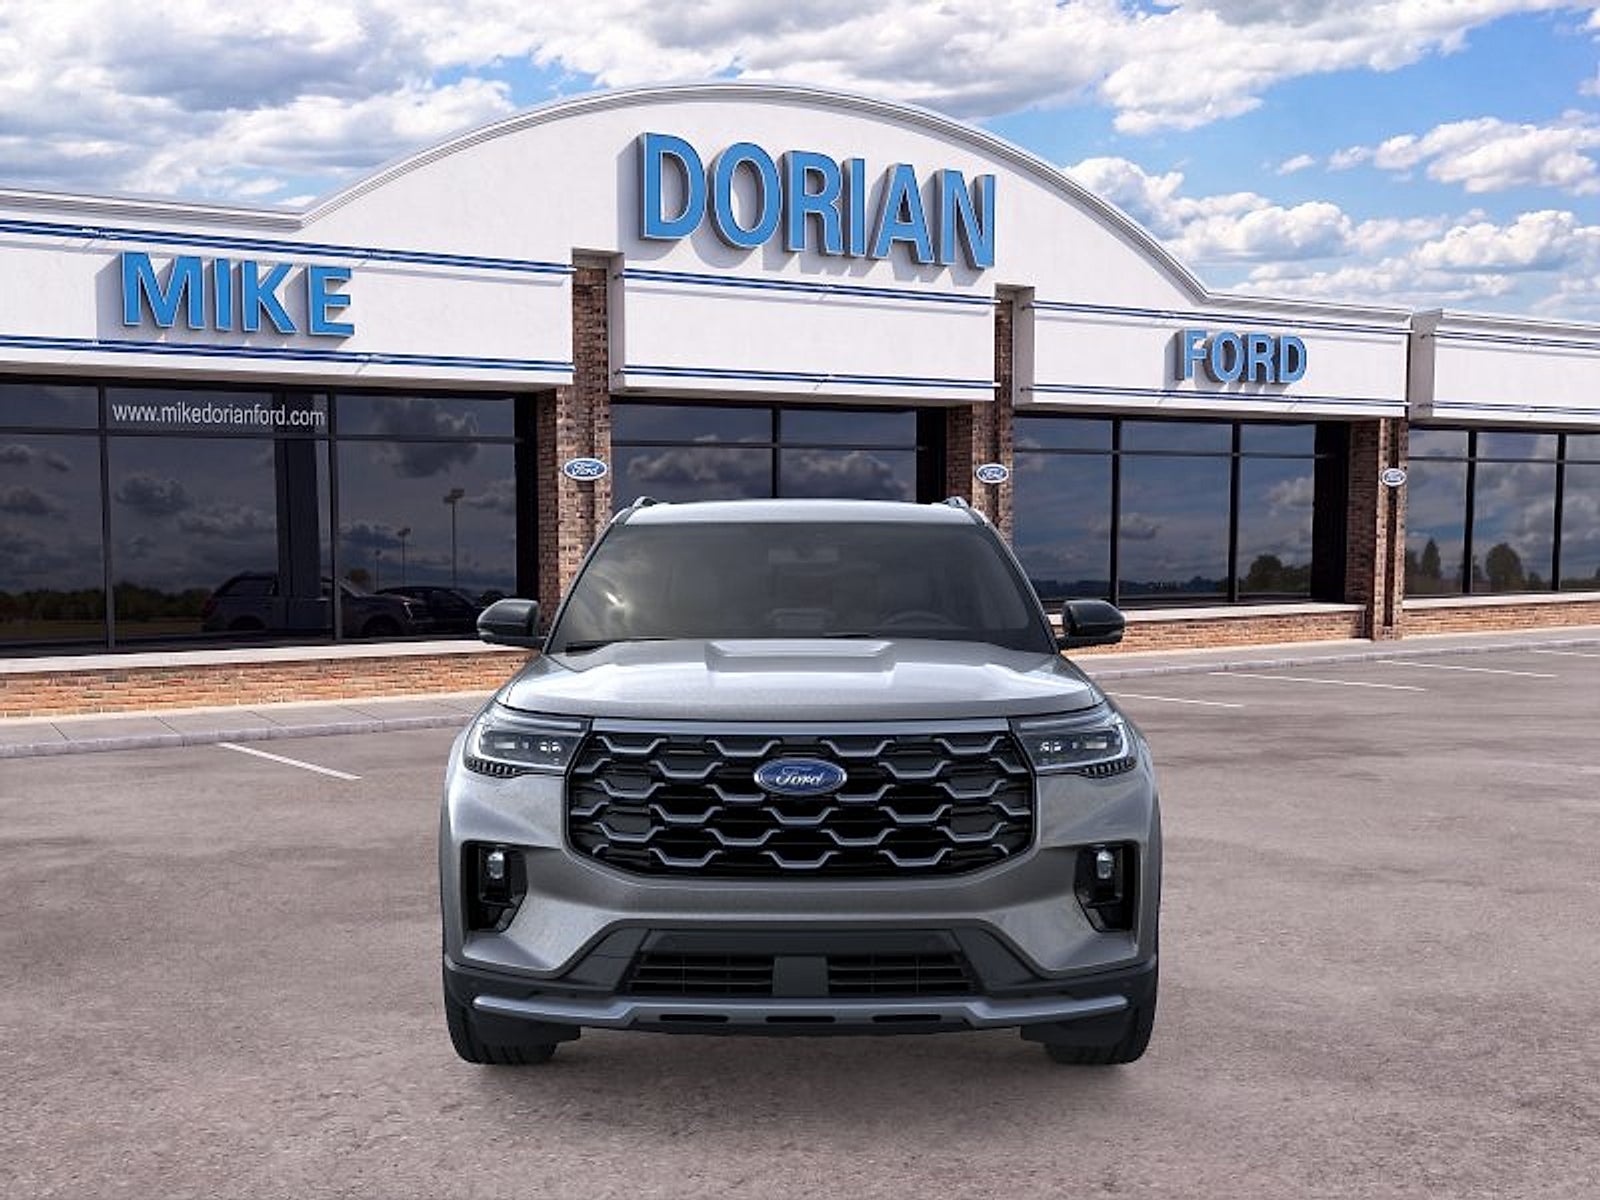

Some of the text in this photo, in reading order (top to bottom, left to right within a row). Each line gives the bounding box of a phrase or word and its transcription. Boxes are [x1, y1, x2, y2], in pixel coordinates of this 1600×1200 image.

[641, 132, 996, 269] DORIAN
[121, 252, 355, 337] MIKE
[1182, 328, 1307, 384] FORD
[112, 402, 325, 426] www.mikedorianford.com
[776, 766, 825, 786] Ford
